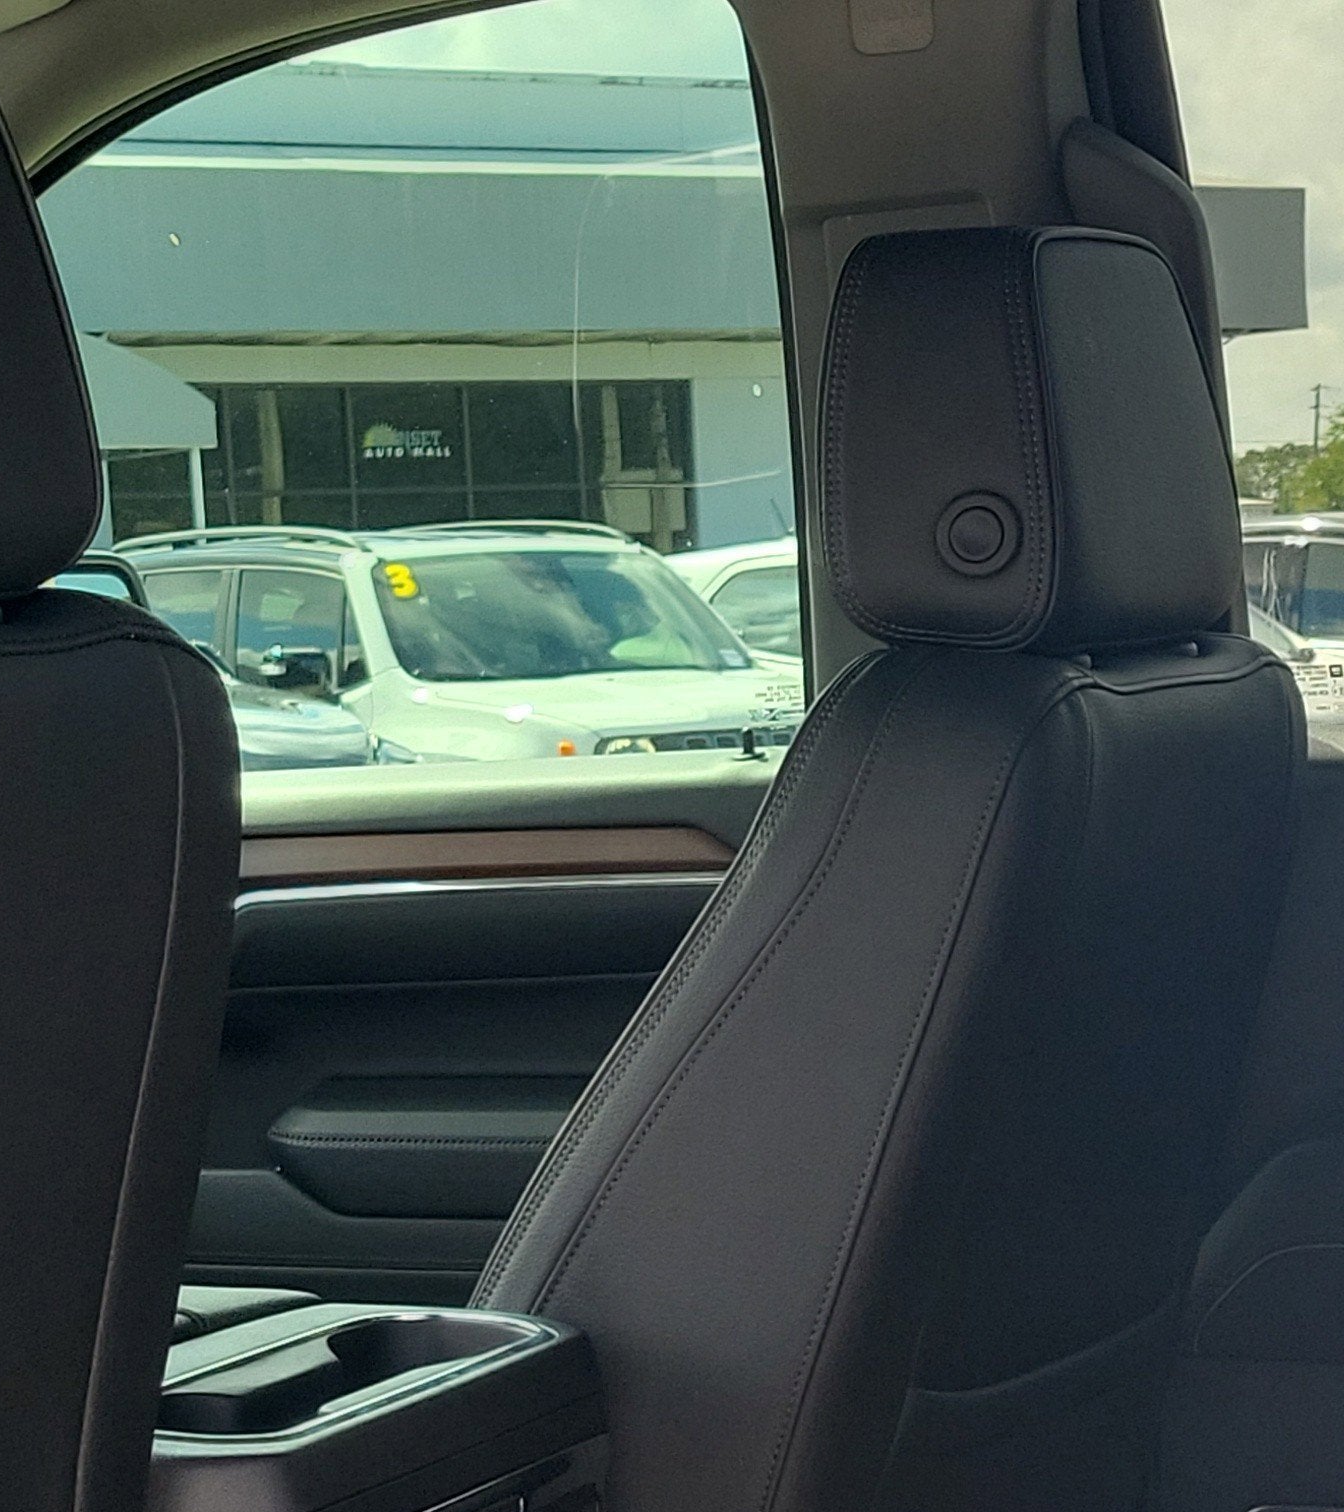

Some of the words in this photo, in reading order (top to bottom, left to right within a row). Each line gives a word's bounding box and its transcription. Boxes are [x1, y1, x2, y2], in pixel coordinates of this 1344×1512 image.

[363, 447, 405, 458] AUTO
[412, 446, 452, 458] MALL
[385, 563, 419, 599] 3
